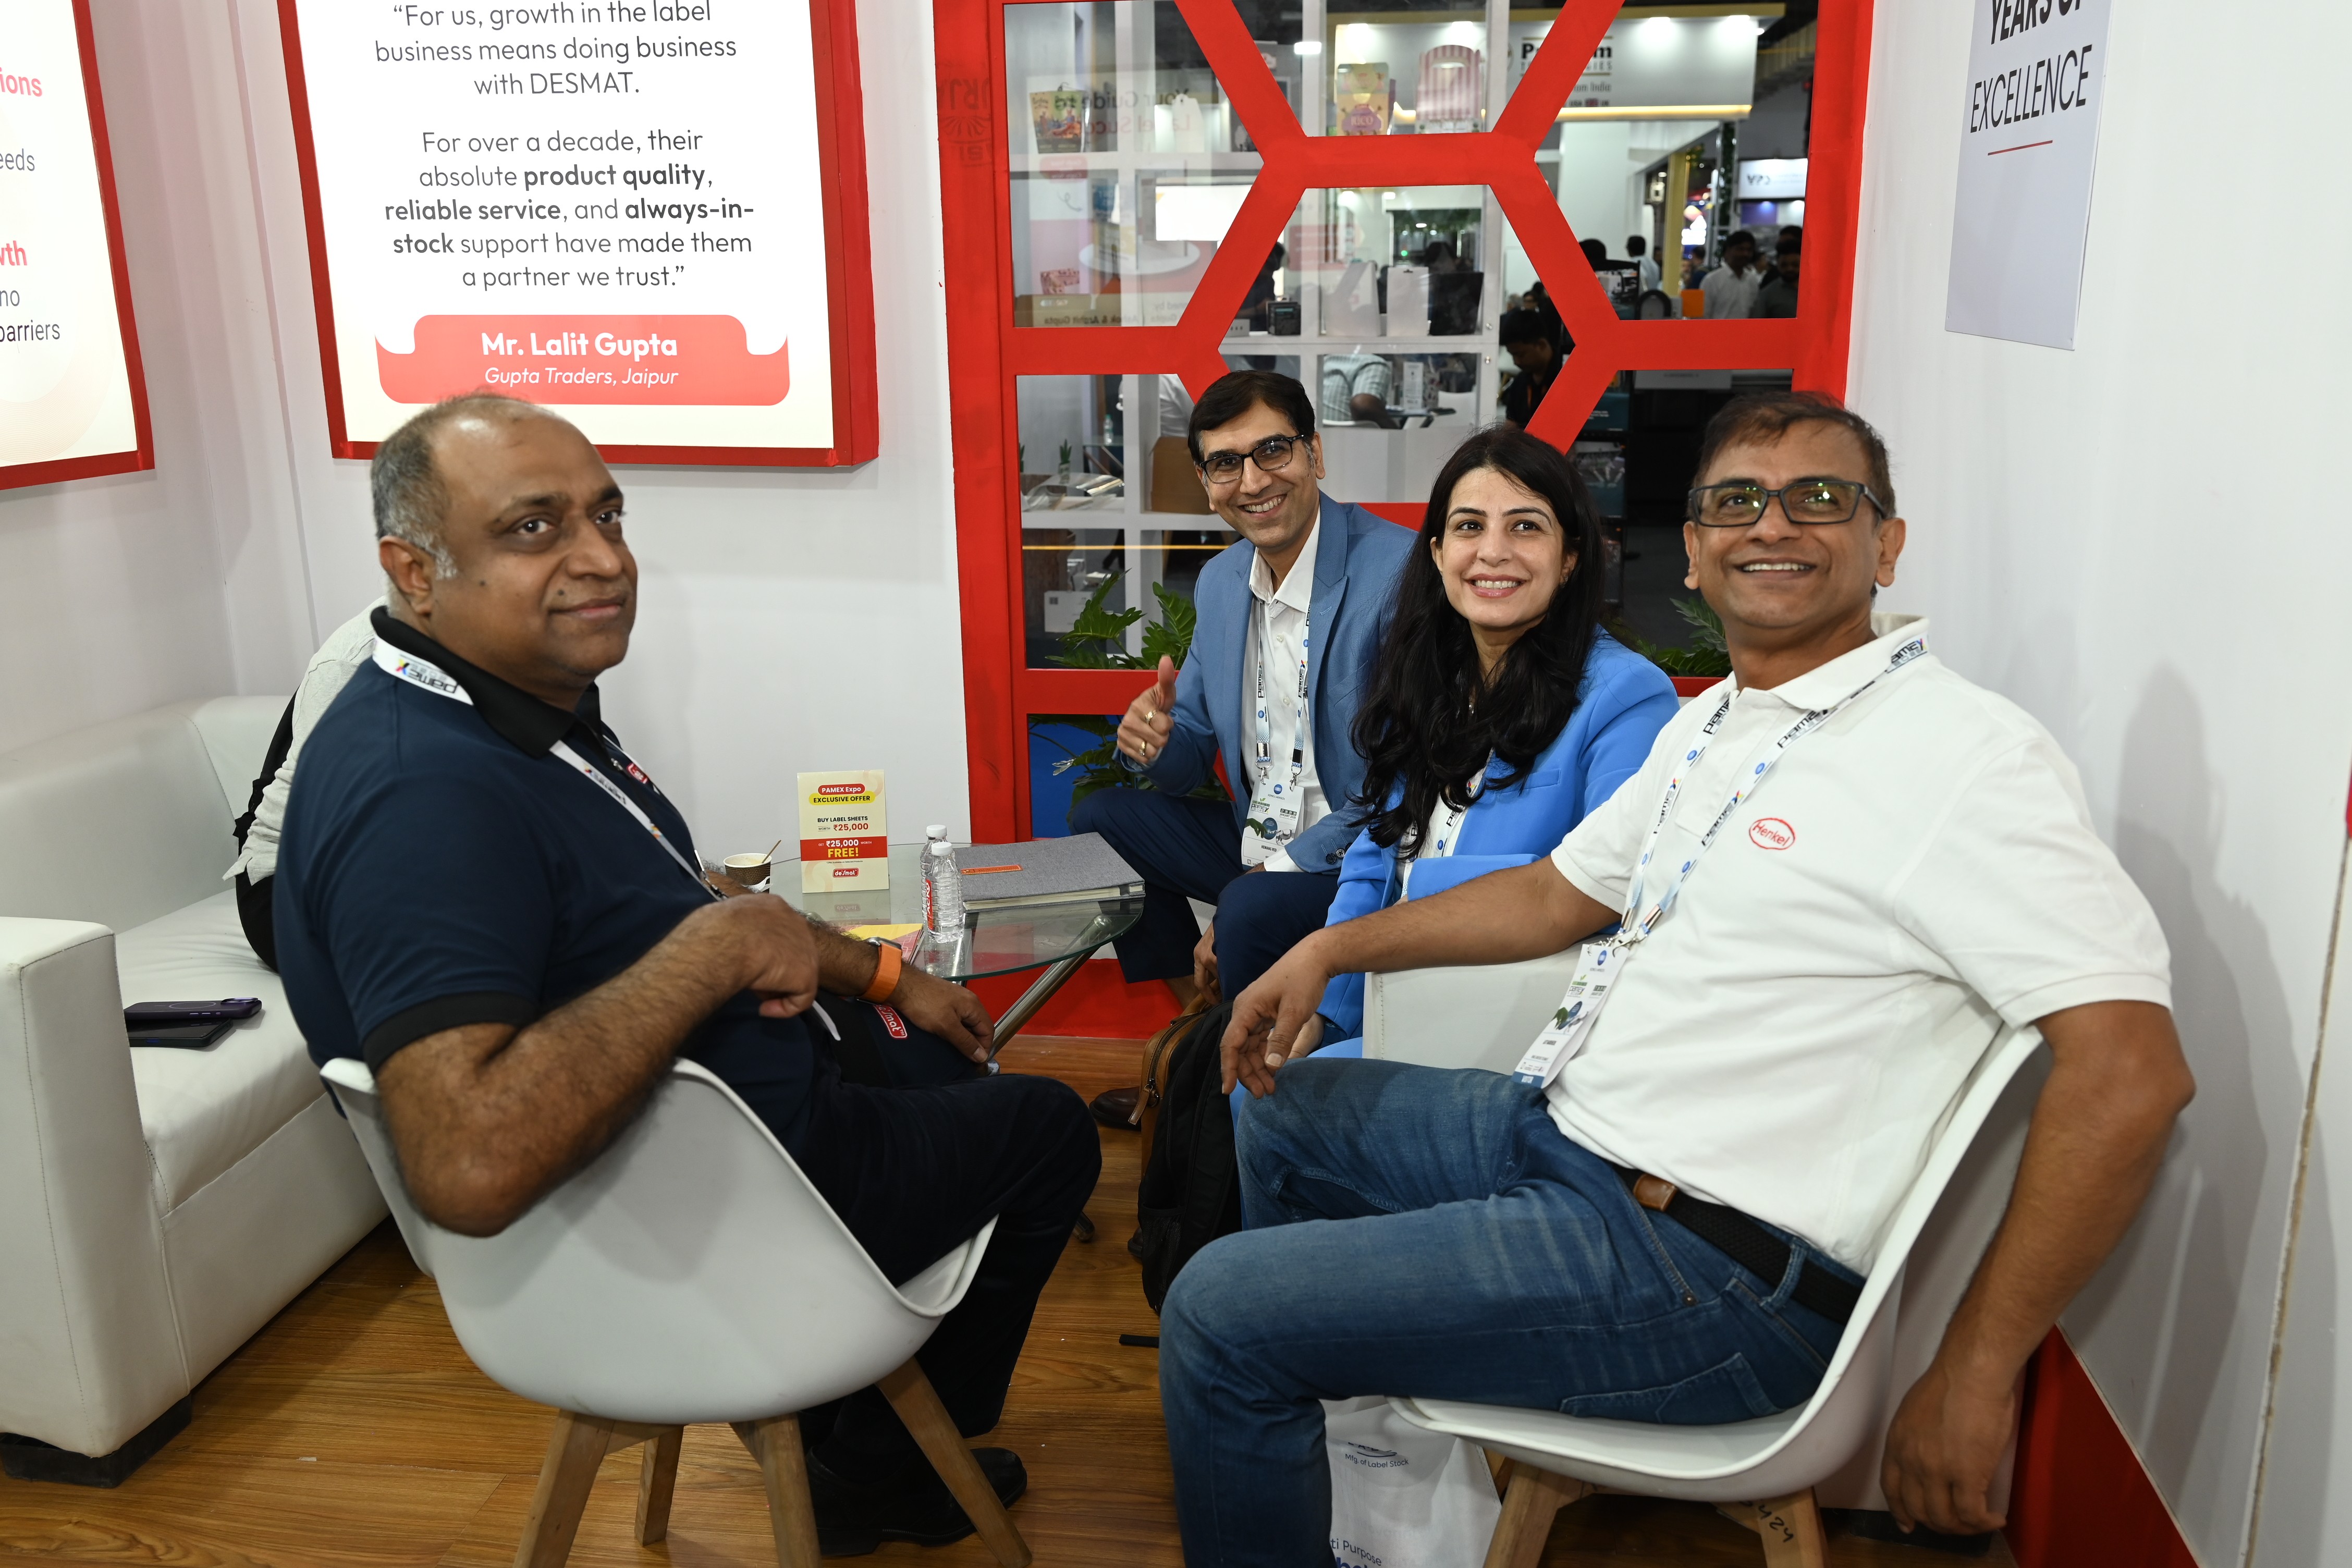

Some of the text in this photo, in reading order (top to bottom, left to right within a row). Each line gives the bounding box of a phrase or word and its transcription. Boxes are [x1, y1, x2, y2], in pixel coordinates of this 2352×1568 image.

[452, 10, 482, 28] us,
[491, 2, 573, 30] growth
[581, 2, 600, 22] in
[607, 1, 646, 22] the
[654, 0, 710, 21] label
[376, 36, 736, 64] business means doing business
[474, 72, 639, 94] with DESMAT.
[1970, 44, 2092, 133] EXCELLENCE
[423, 129, 703, 154] For over a decade, their
[420, 163, 712, 191] absolute product quality,
[386, 198, 753, 224] reliable service, and always-in-
[394, 231, 751, 258] stock support have made them
[463, 273, 475, 286] a
[484, 267, 570, 291] partner
[577, 272, 609, 286] we
[482, 332, 677, 362] Mr. Lalit Gupta
[485, 368, 679, 388] Gupta Traders, Jaipur
[833, 823, 868, 831] ₹25,000
[1753, 822, 1790, 846] Henkel
[826, 839, 859, 848] ₹25,000
[828, 847, 859, 858] FREE!
[1390, 1459, 1409, 1467] Stock
[1343, 1540, 1381, 1566] Purpose
